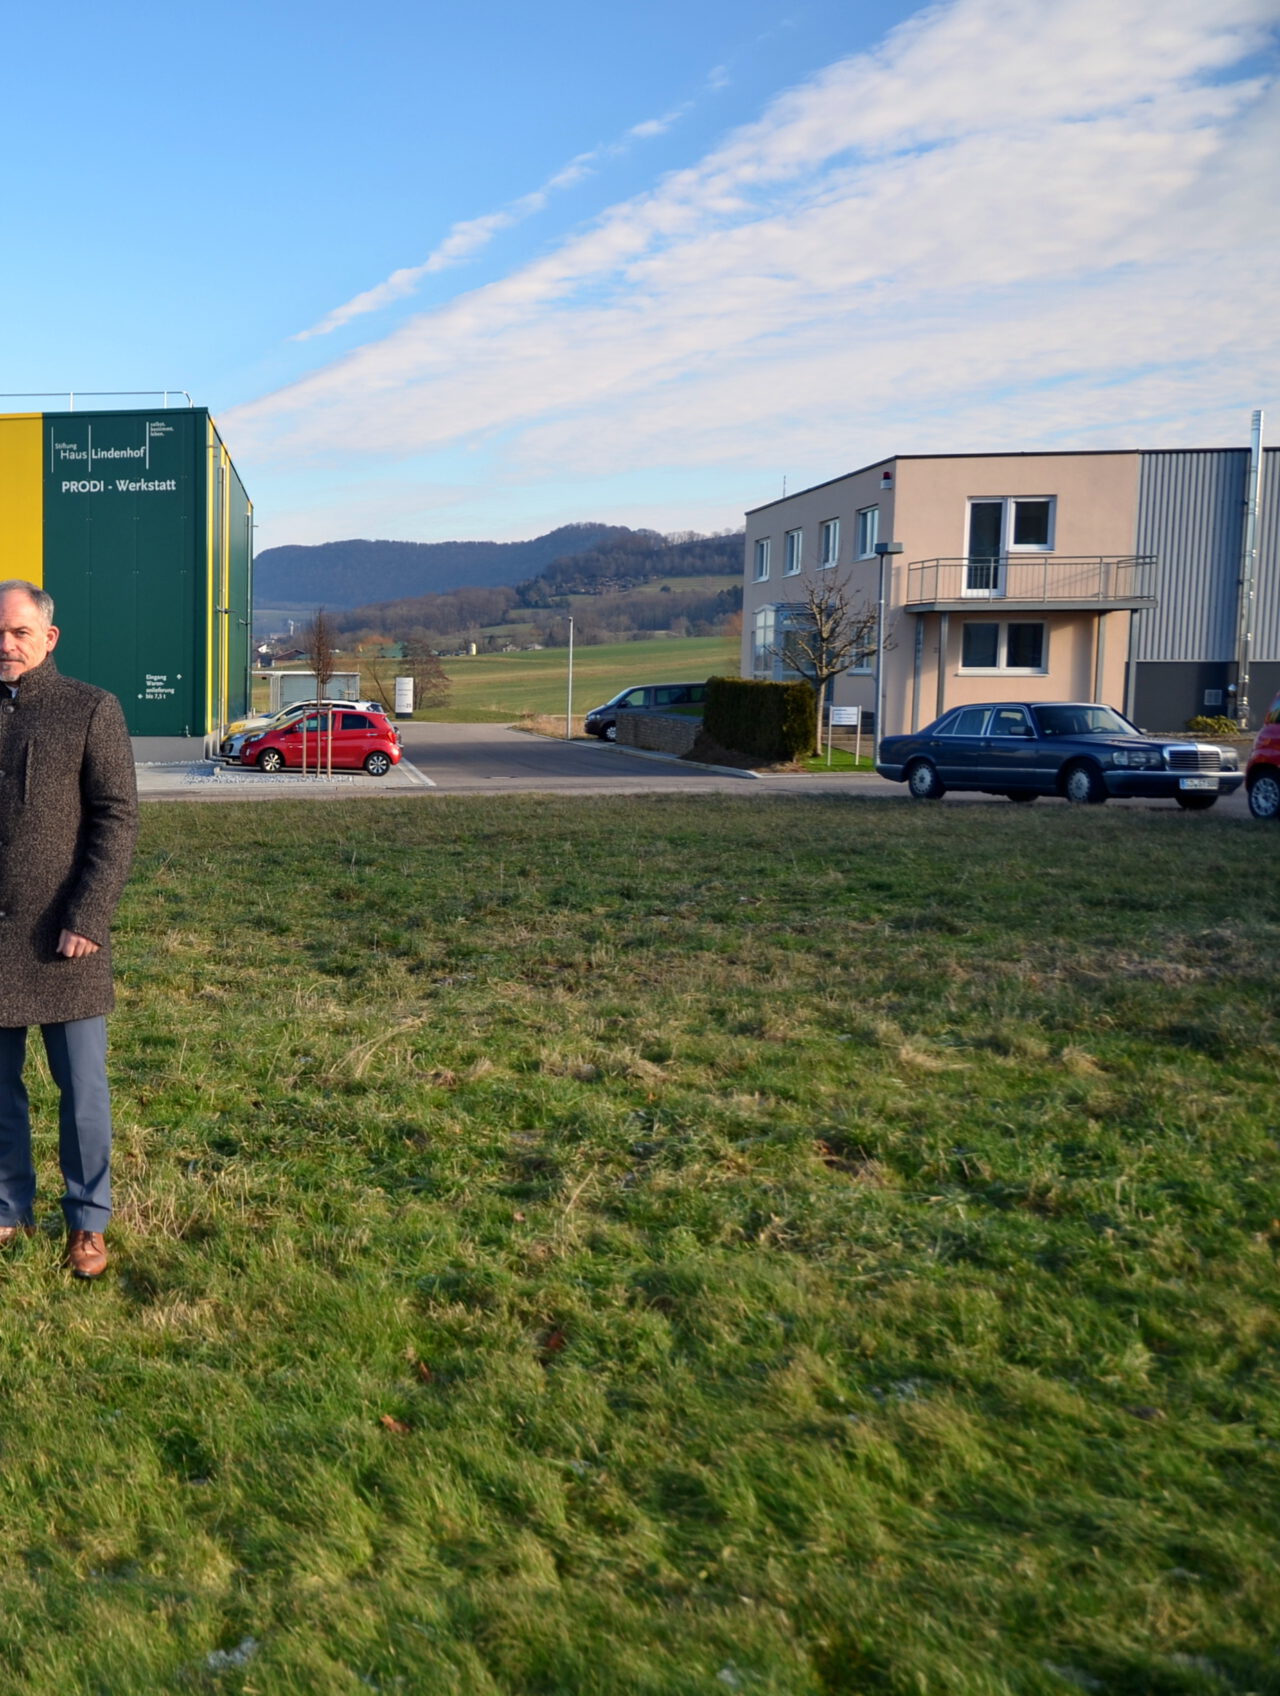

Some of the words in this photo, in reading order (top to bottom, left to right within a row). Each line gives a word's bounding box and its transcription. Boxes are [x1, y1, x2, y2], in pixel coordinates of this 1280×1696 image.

[61, 450, 87, 460] Haus
[92, 447, 145, 459] Lindenhof
[62, 480, 104, 493] PRODI
[116, 479, 176, 491] Werkstatt
